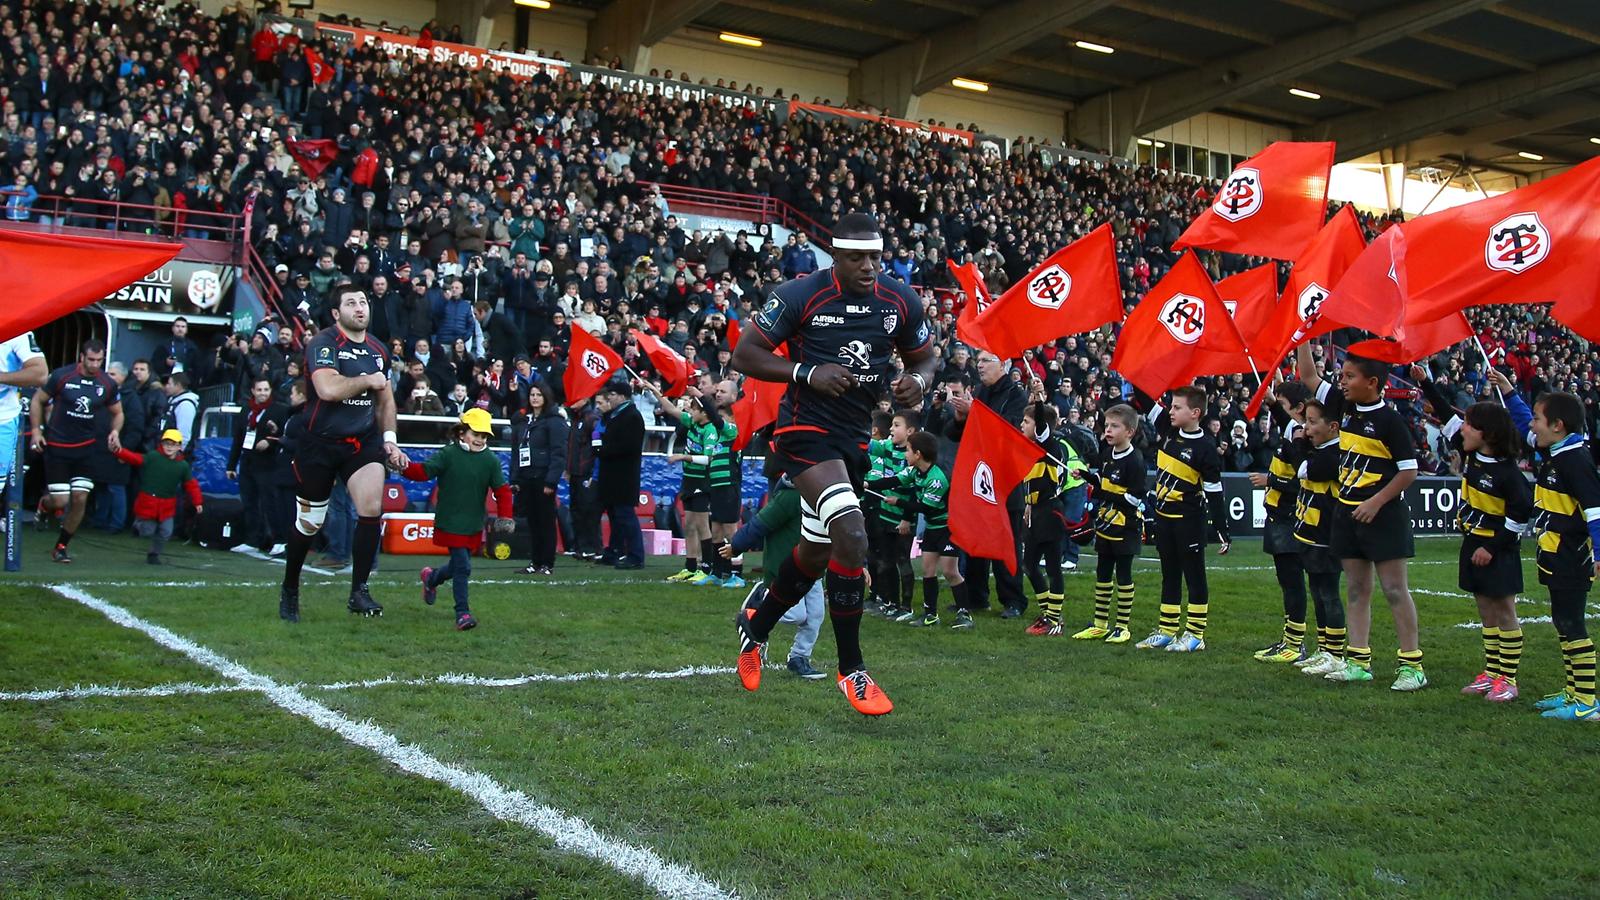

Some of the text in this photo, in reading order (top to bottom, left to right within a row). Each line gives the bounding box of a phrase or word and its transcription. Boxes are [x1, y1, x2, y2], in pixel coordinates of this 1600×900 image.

[364, 34, 560, 80] Epaces Stde Toulousin
[812, 315, 845, 324] AIRBUS
[846, 305, 872, 314] BLK
[7, 510, 16, 549] CHAMPIONS
